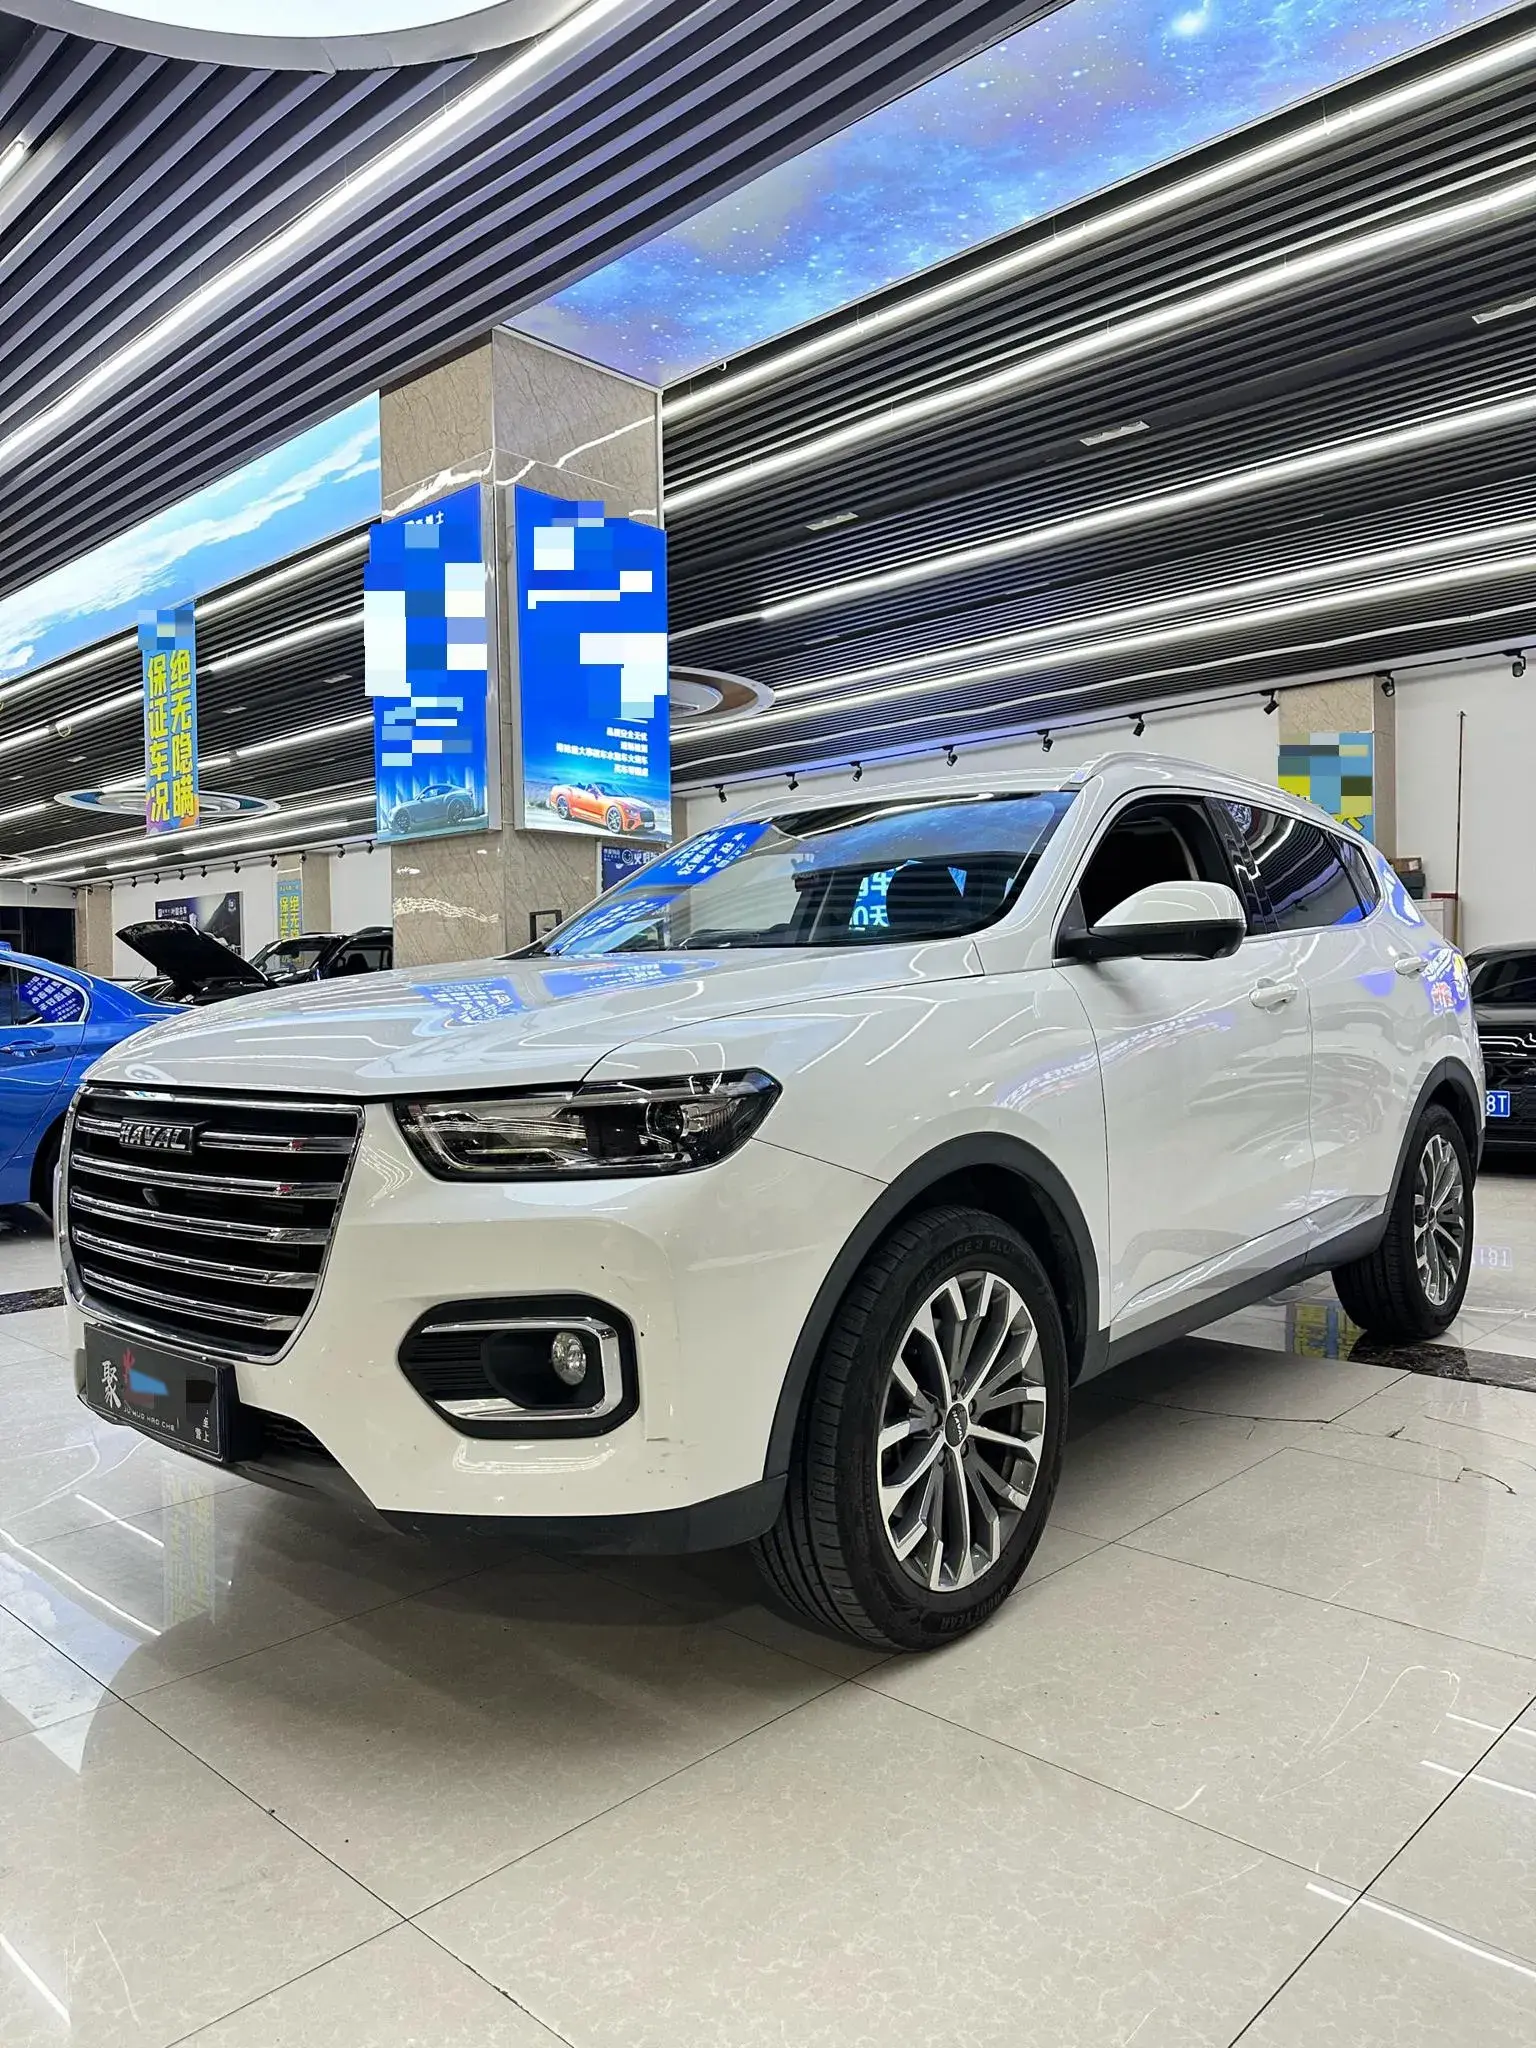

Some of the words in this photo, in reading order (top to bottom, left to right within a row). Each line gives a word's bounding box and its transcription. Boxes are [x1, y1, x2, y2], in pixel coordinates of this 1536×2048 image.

[148, 654, 170, 822] 保证车况
[170, 649, 195, 818] 绝无隐瞒
[119, 1123, 186, 1150] HAVAL
[951, 1410, 963, 1441] HAVAL
